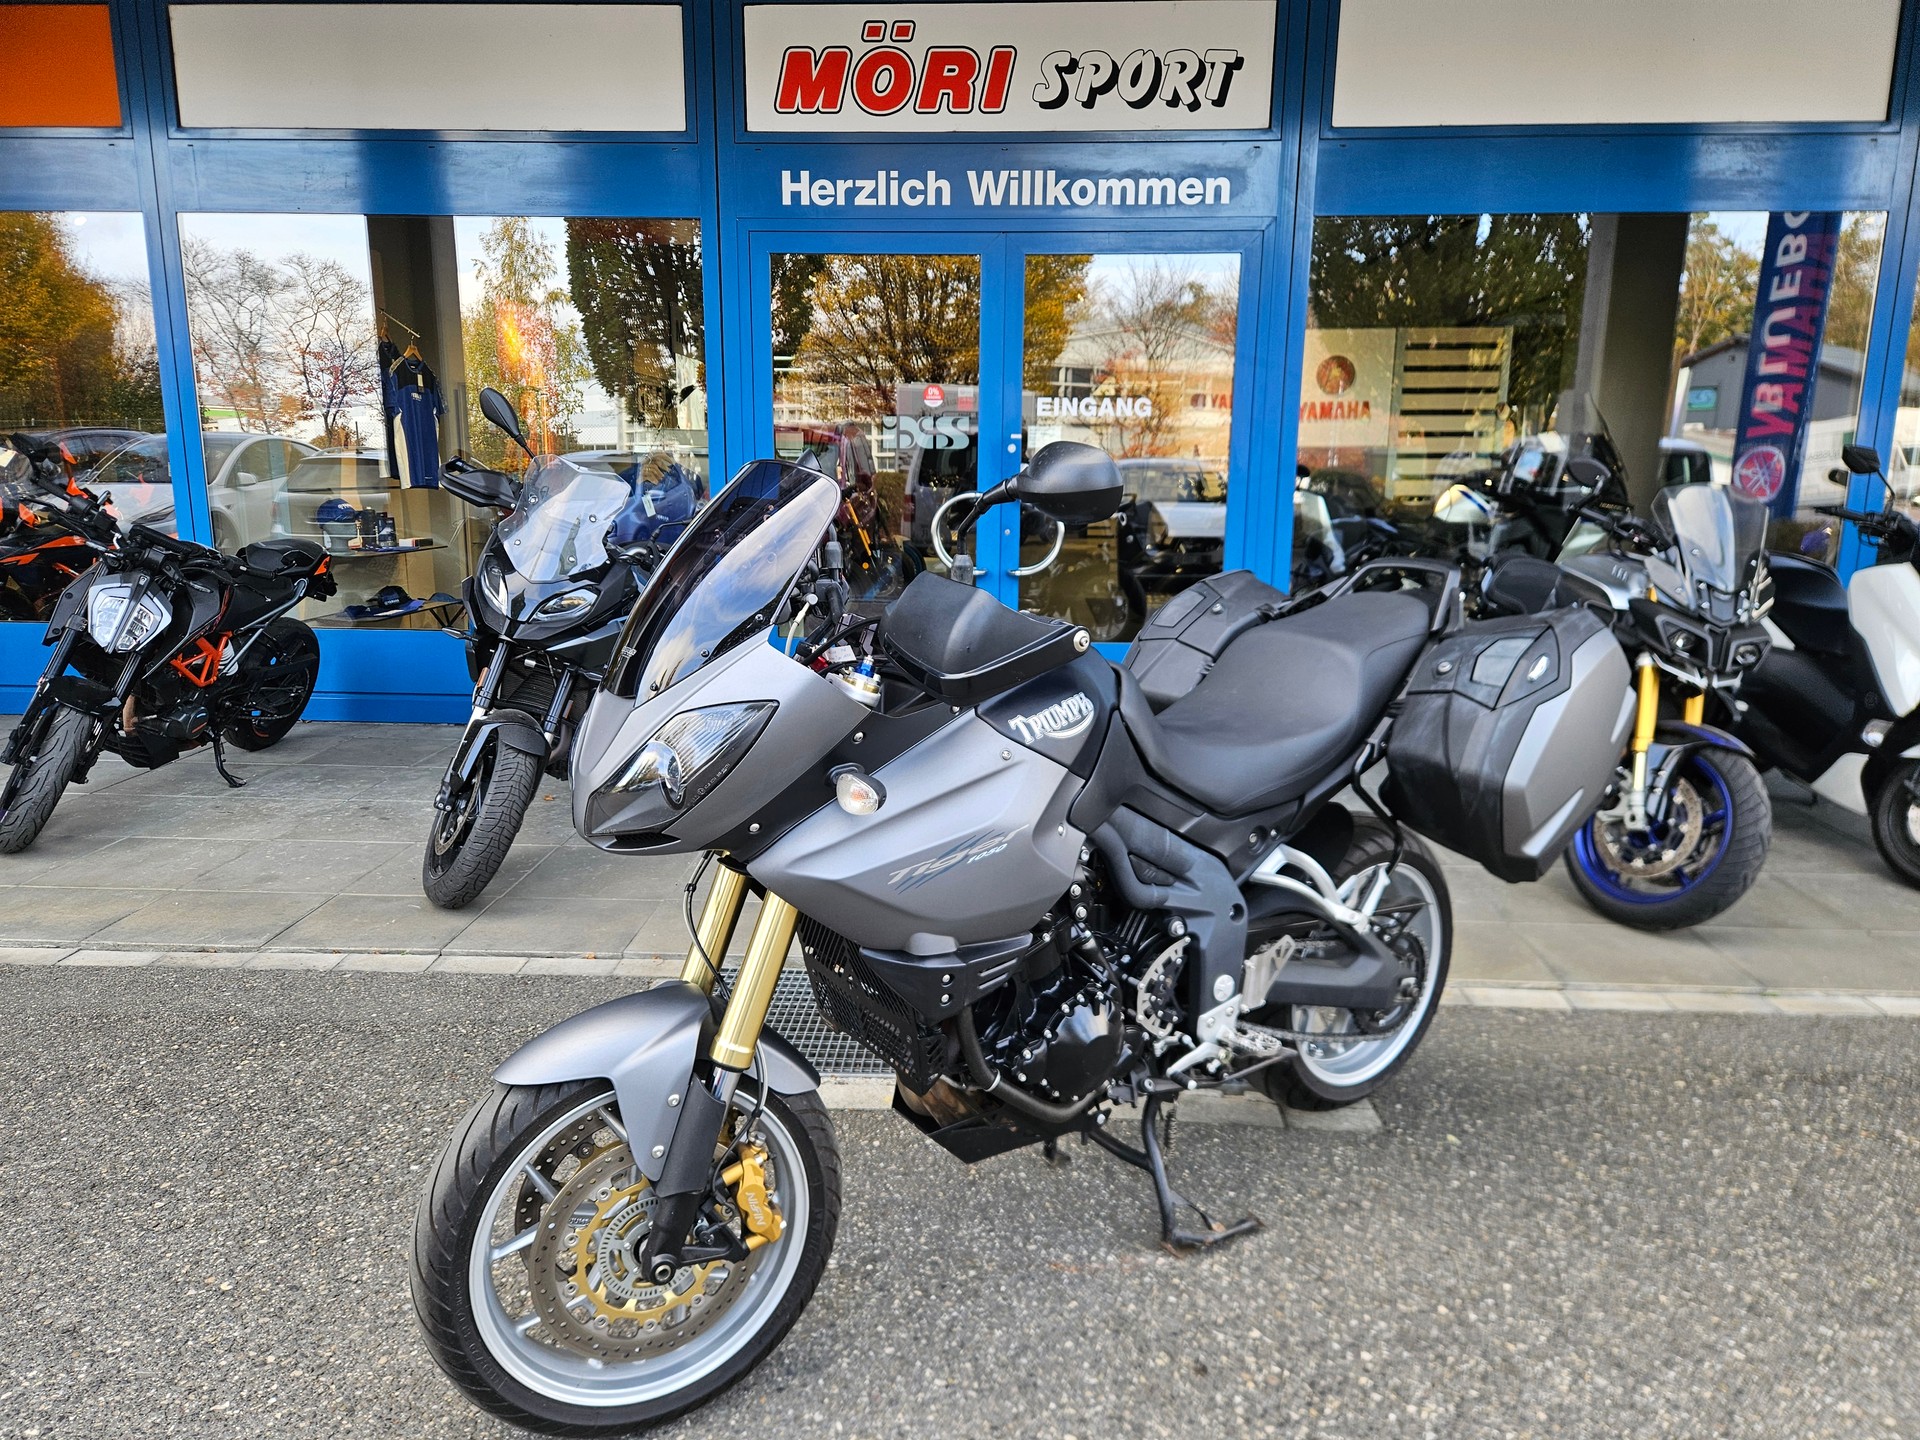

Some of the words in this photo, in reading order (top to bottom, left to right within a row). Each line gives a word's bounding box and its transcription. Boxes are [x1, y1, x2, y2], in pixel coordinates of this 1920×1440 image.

[774, 20, 1017, 116] MÖRI
[1032, 49, 1244, 112] SPORT
[781, 170, 951, 206] Herzlich
[967, 169, 1230, 206] Willkommen
[1036, 397, 1152, 417] EINGANG
[1299, 400, 1371, 422] YAMAHA
[1008, 692, 1094, 744] TRIUMPH
[967, 843, 1008, 864] 1050
